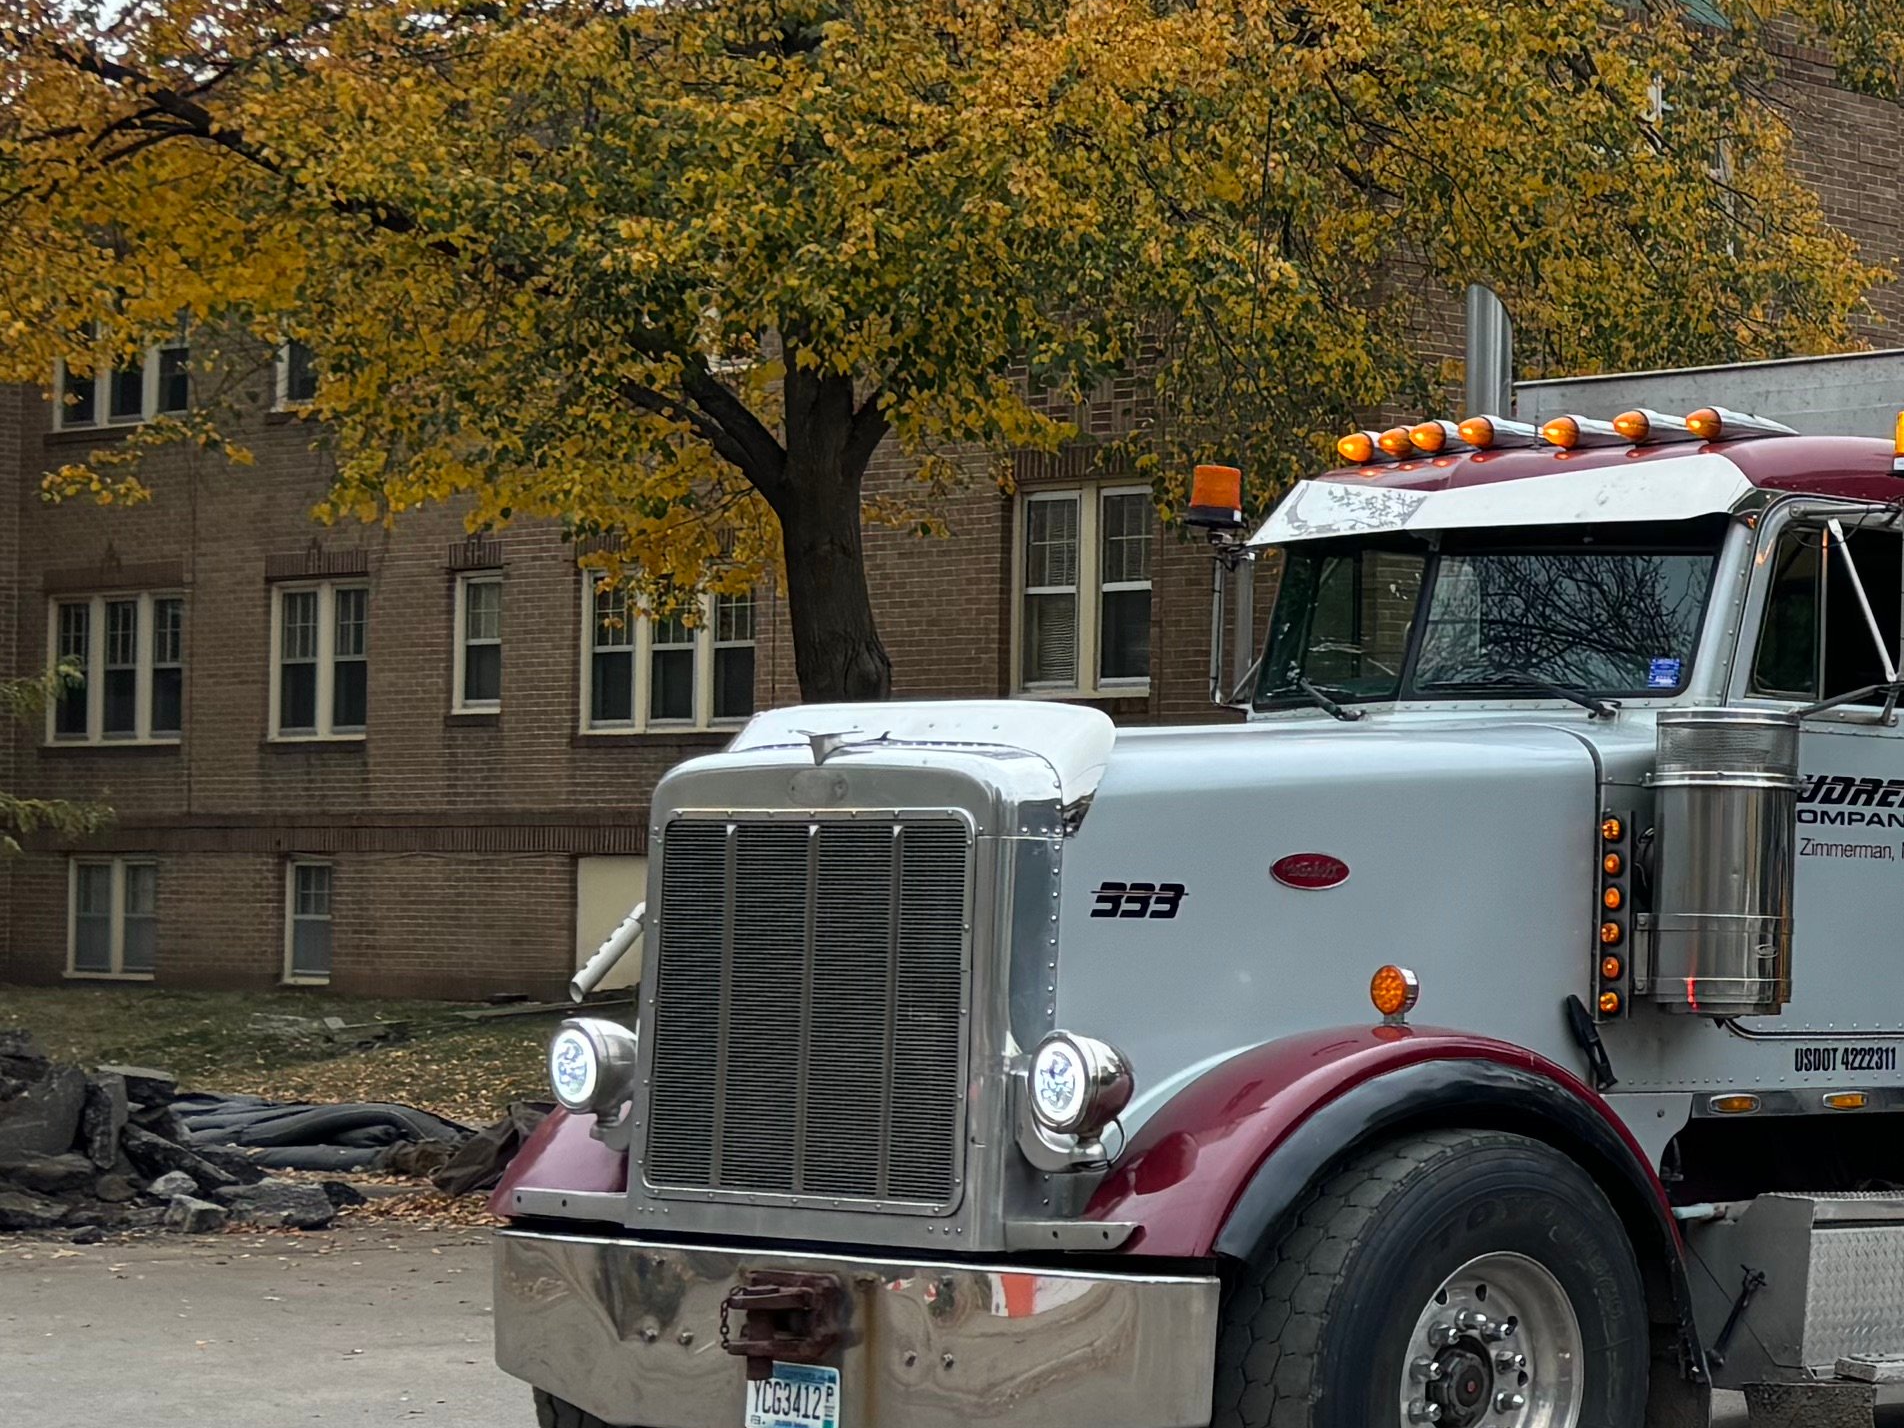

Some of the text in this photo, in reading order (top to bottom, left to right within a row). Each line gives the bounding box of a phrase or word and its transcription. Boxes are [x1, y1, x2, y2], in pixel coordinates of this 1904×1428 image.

[1800, 838, 1895, 861] Zimmerman,
[1090, 882, 1189, 918] 333
[1795, 1047, 1896, 1072] USDOT 4222311
[754, 1380, 822, 1421] YCG3412
